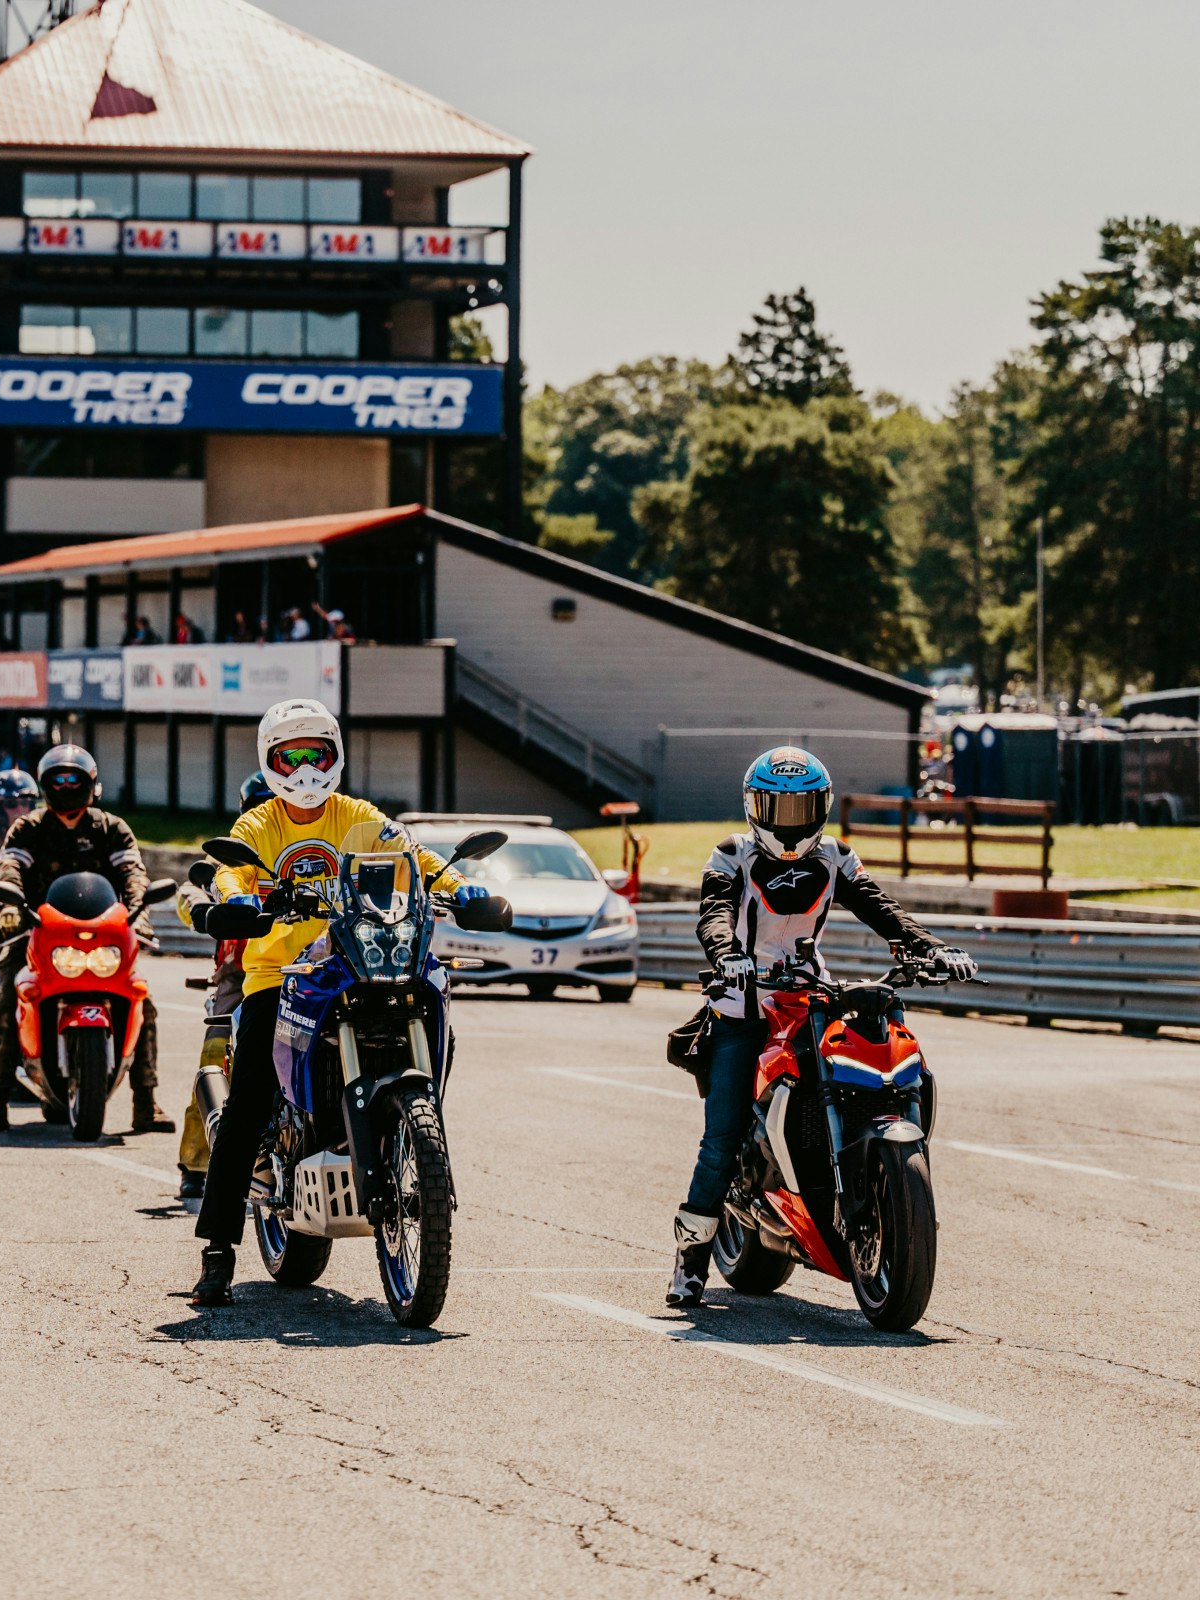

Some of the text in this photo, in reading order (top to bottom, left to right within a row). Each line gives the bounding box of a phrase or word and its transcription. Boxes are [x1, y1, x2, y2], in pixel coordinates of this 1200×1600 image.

[241, 373, 473, 406] COOPER
[70, 401, 185, 424] TIRES
[351, 405, 466, 429] TIRES
[775, 766, 805, 774] HJC
[531, 948, 558, 965] 37
